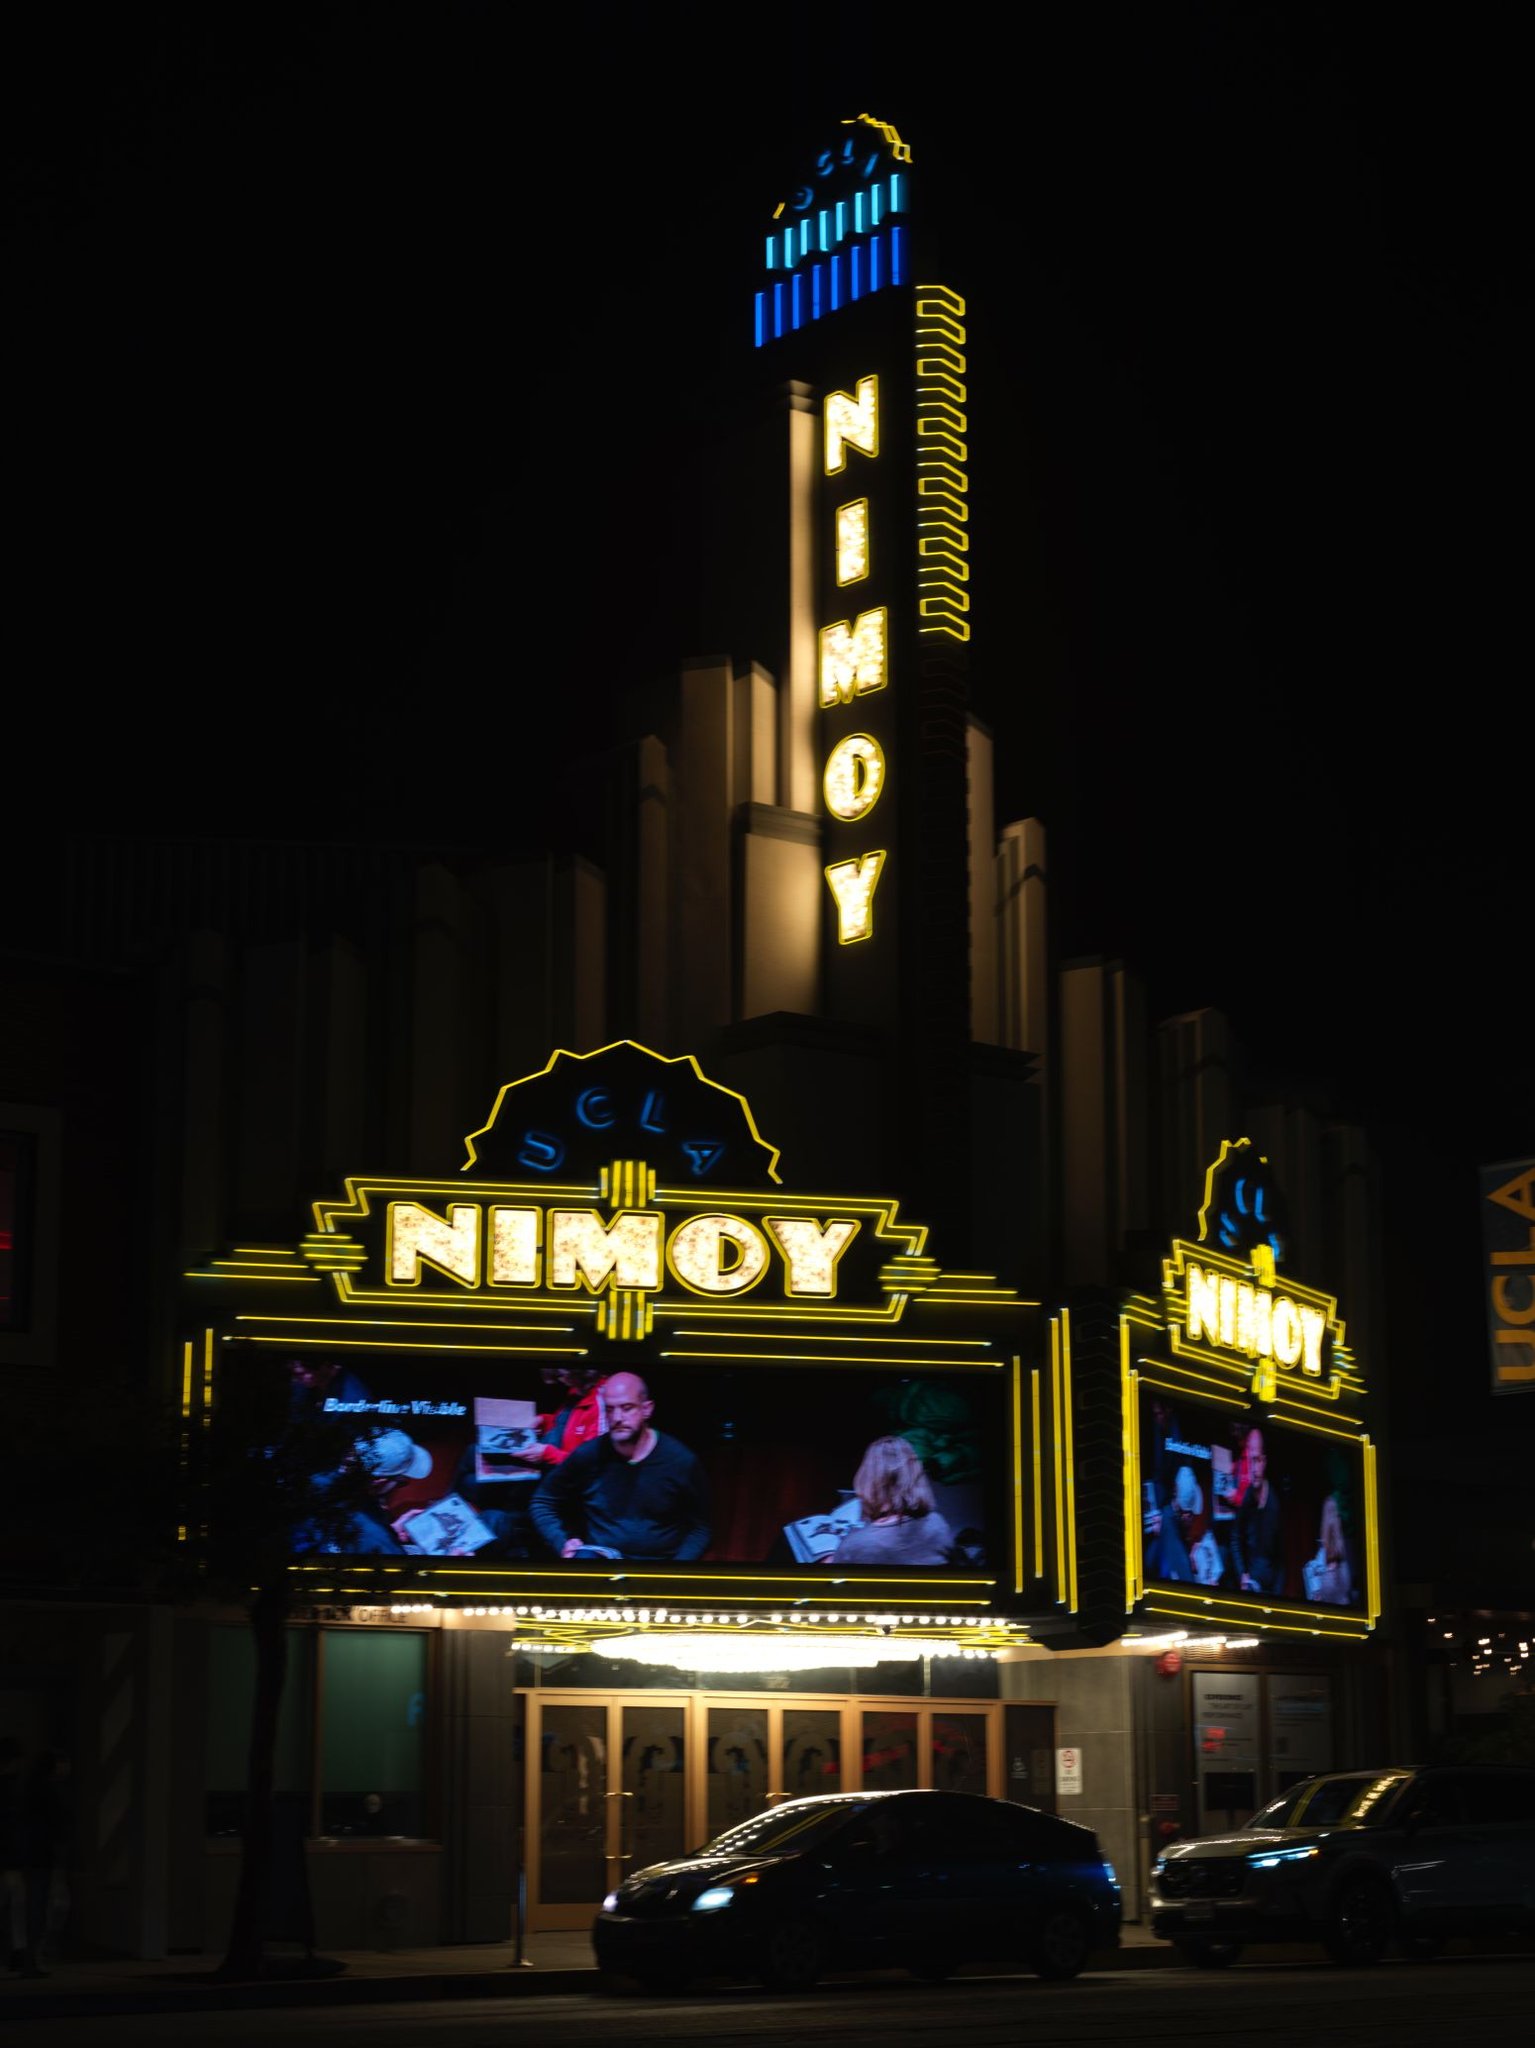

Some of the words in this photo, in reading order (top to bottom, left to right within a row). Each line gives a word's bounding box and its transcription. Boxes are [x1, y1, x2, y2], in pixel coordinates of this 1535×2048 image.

[818, 373, 889, 945] NIMOY
[517, 1087, 726, 1175] UCLA
[385, 1201, 862, 1298] NIMOY
[1486, 1166, 1535, 1382] UCLA
[1186, 1262, 1327, 1377] NIMOY
